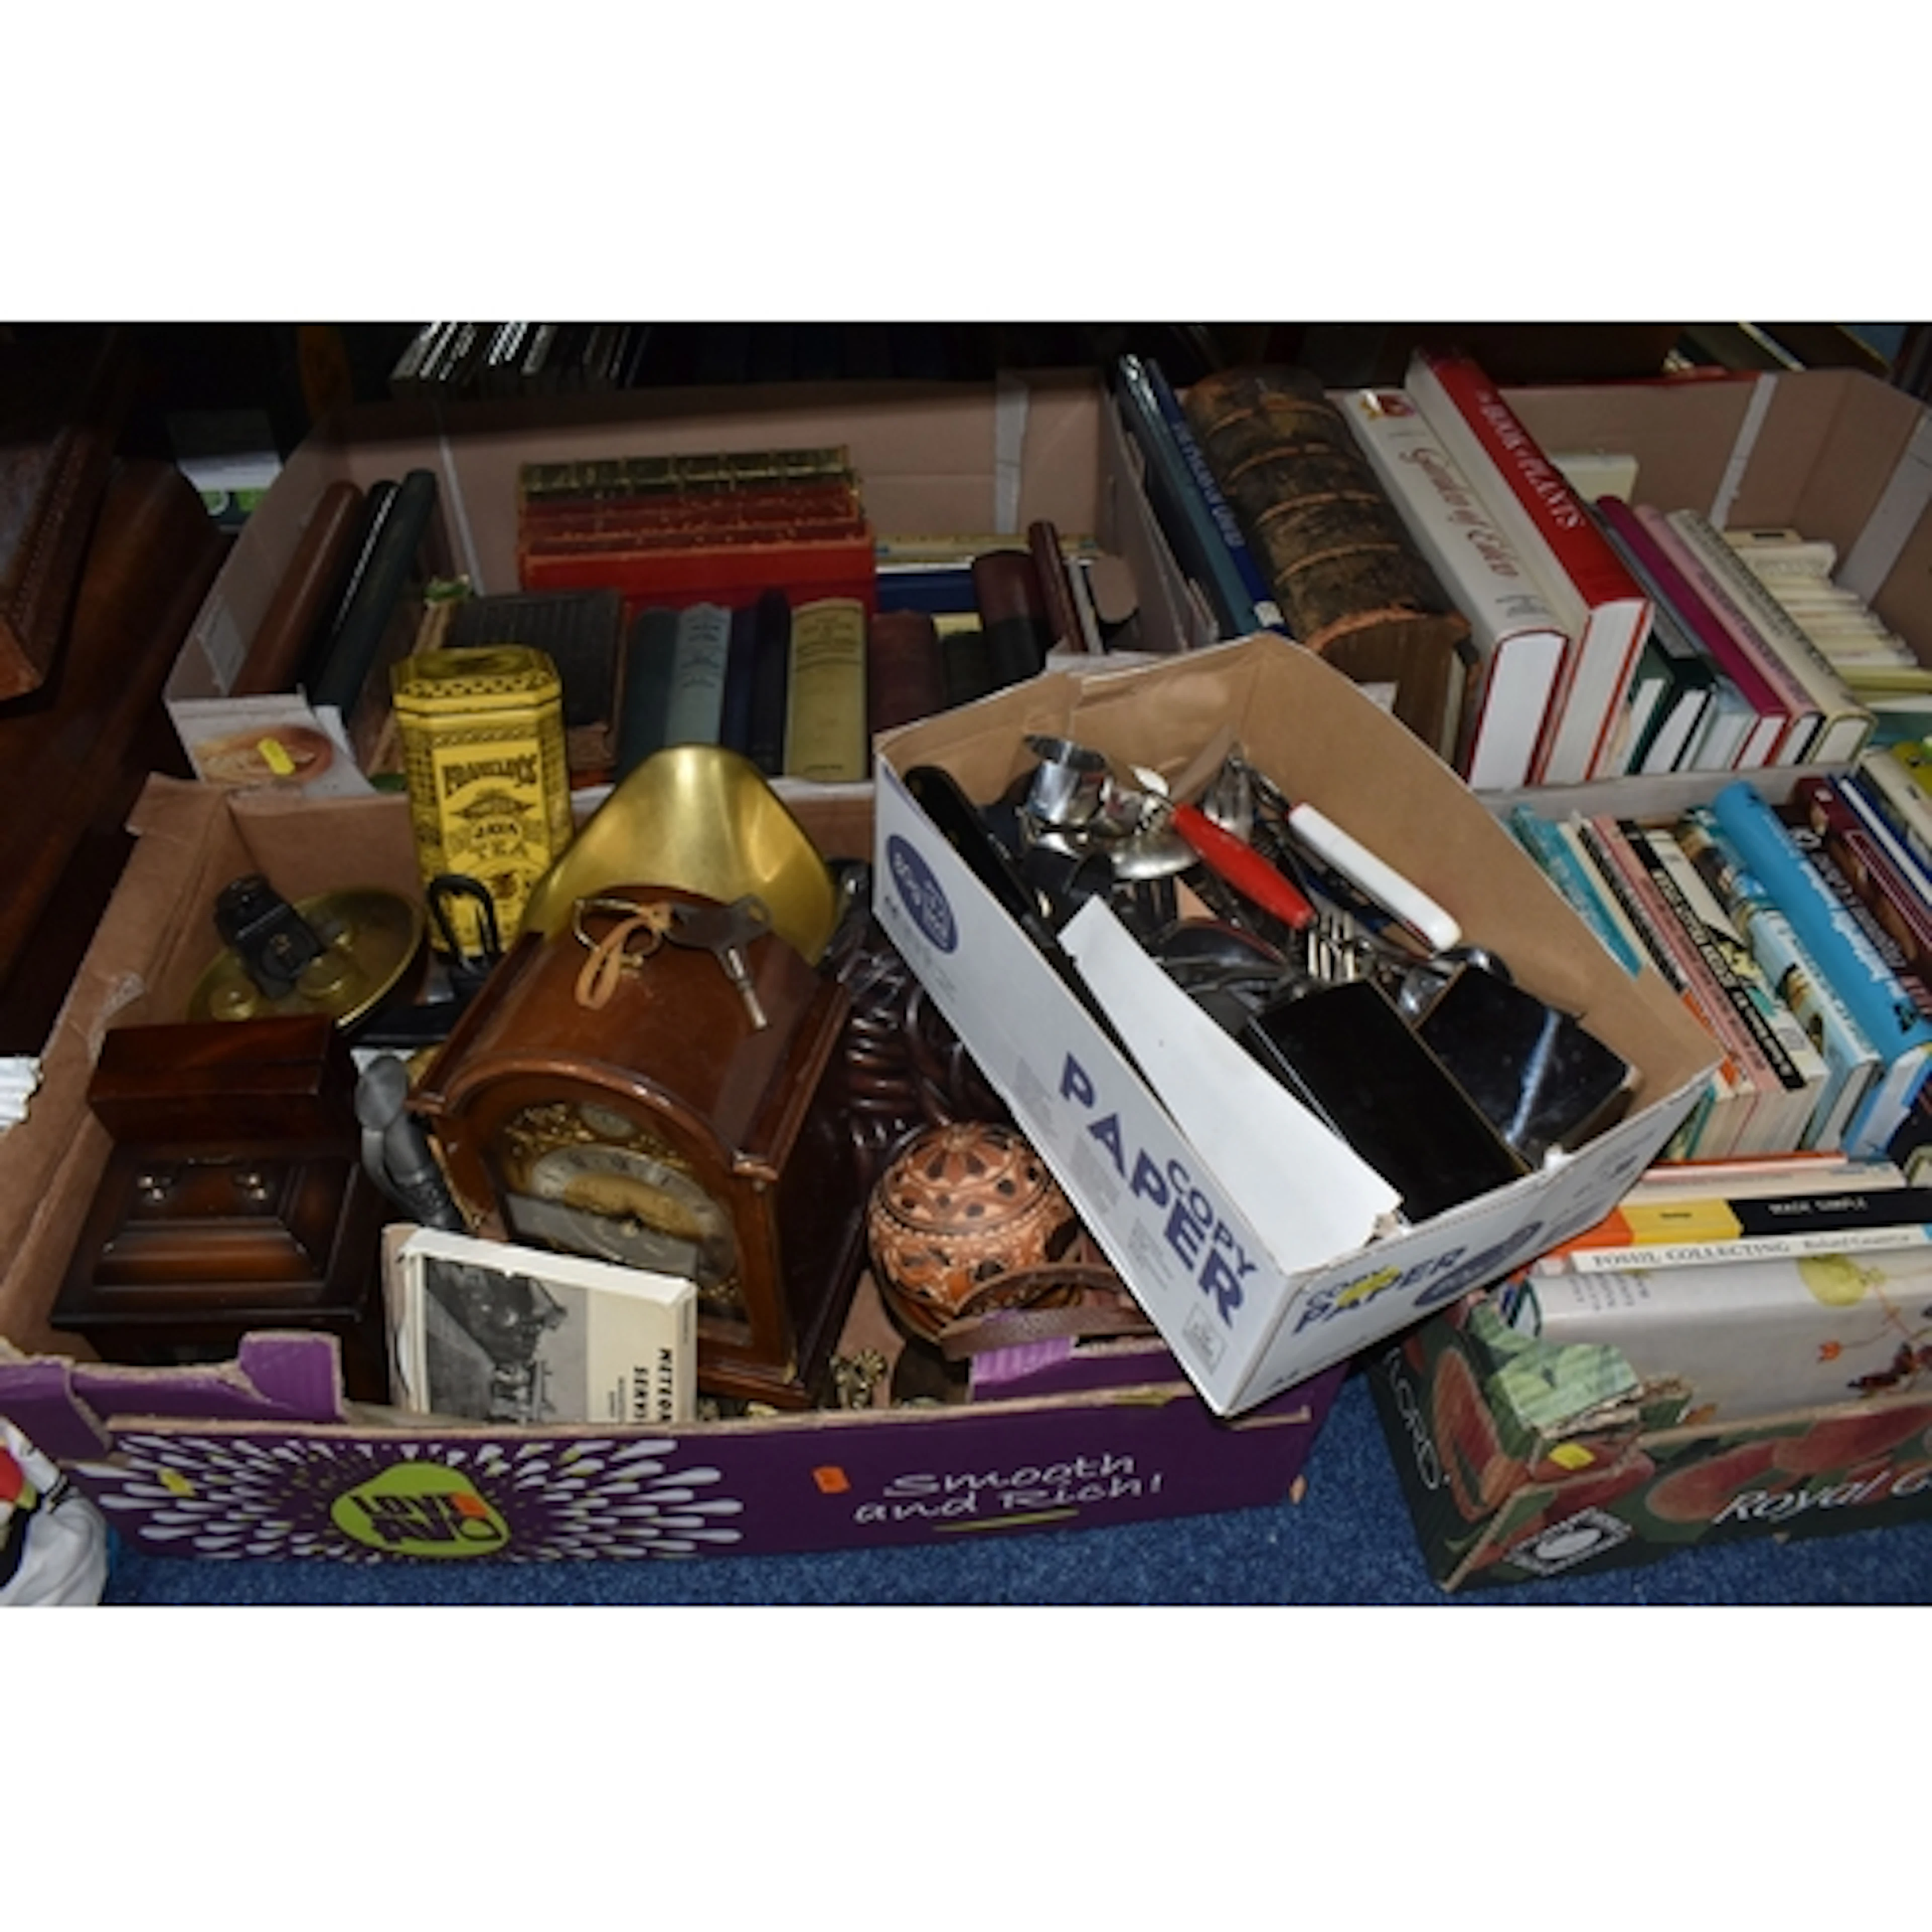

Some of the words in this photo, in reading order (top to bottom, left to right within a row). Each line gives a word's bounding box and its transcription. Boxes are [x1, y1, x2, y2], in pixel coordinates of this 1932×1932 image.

[1059, 1051, 1244, 1328] PAPER
[1166, 1159, 1258, 1278] COPY
[1664, 1240, 1791, 1261] COLLECTING
[855, 1490, 976, 1523] and
[999, 1473, 1162, 1509] Rich!
[883, 1453, 1134, 1498] Smooth
[1712, 1469, 1893, 1524] Royal
